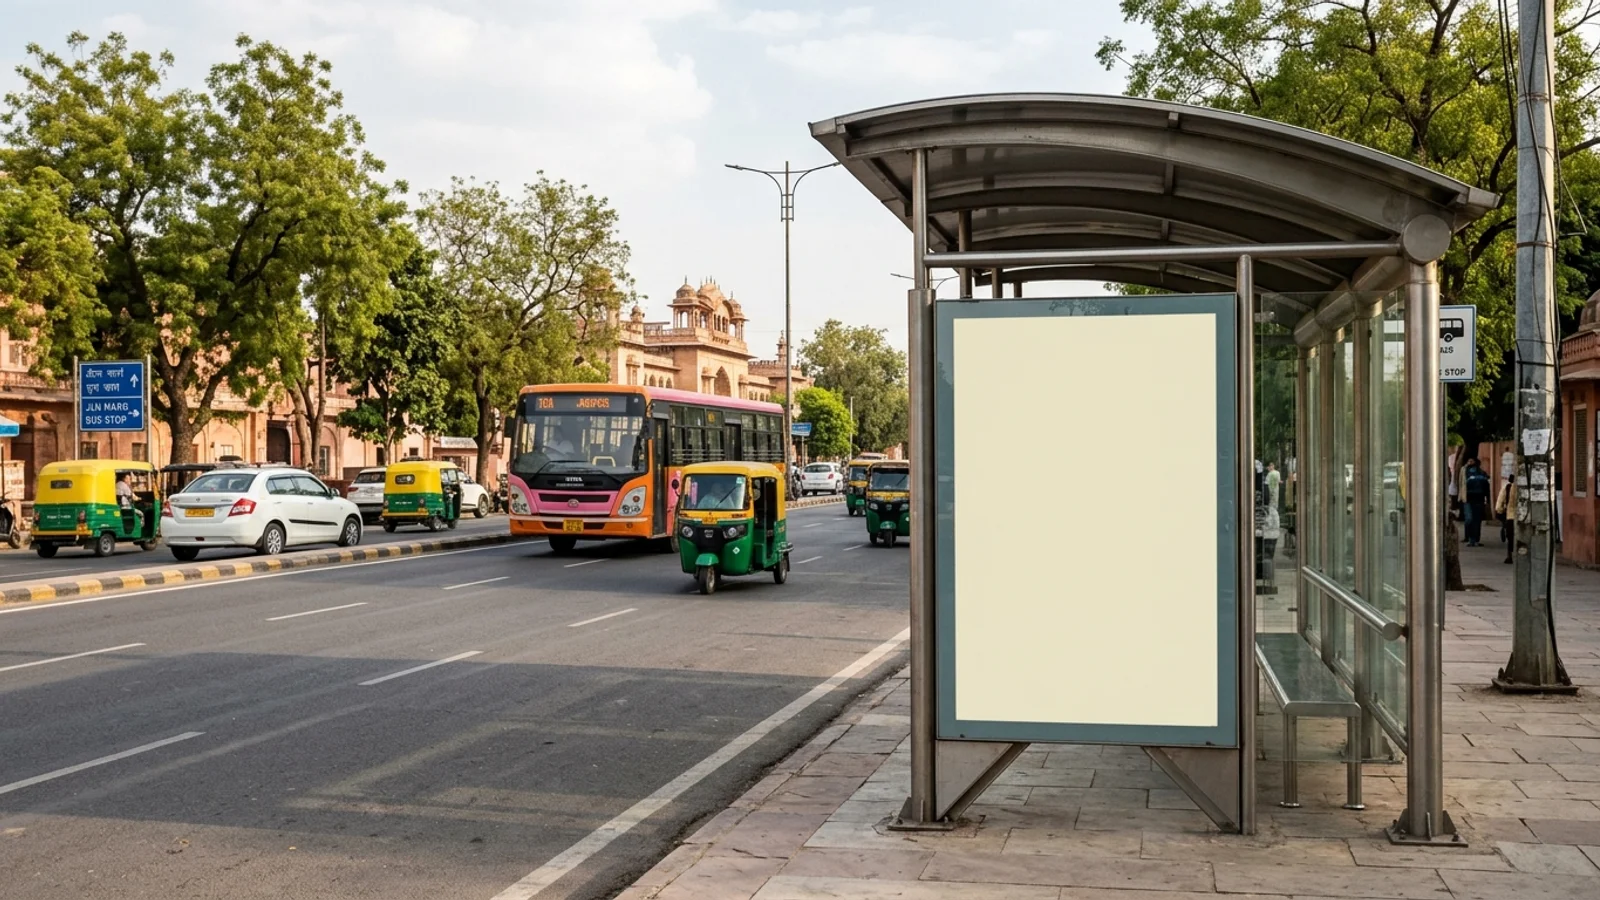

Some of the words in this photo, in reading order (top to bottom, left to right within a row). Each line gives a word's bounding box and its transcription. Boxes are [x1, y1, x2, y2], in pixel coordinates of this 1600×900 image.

[1444, 368, 1466, 376] STOP
[85, 402, 102, 412] JLN
[103, 402, 129, 411] MARG
[104, 415, 127, 424] STOP
